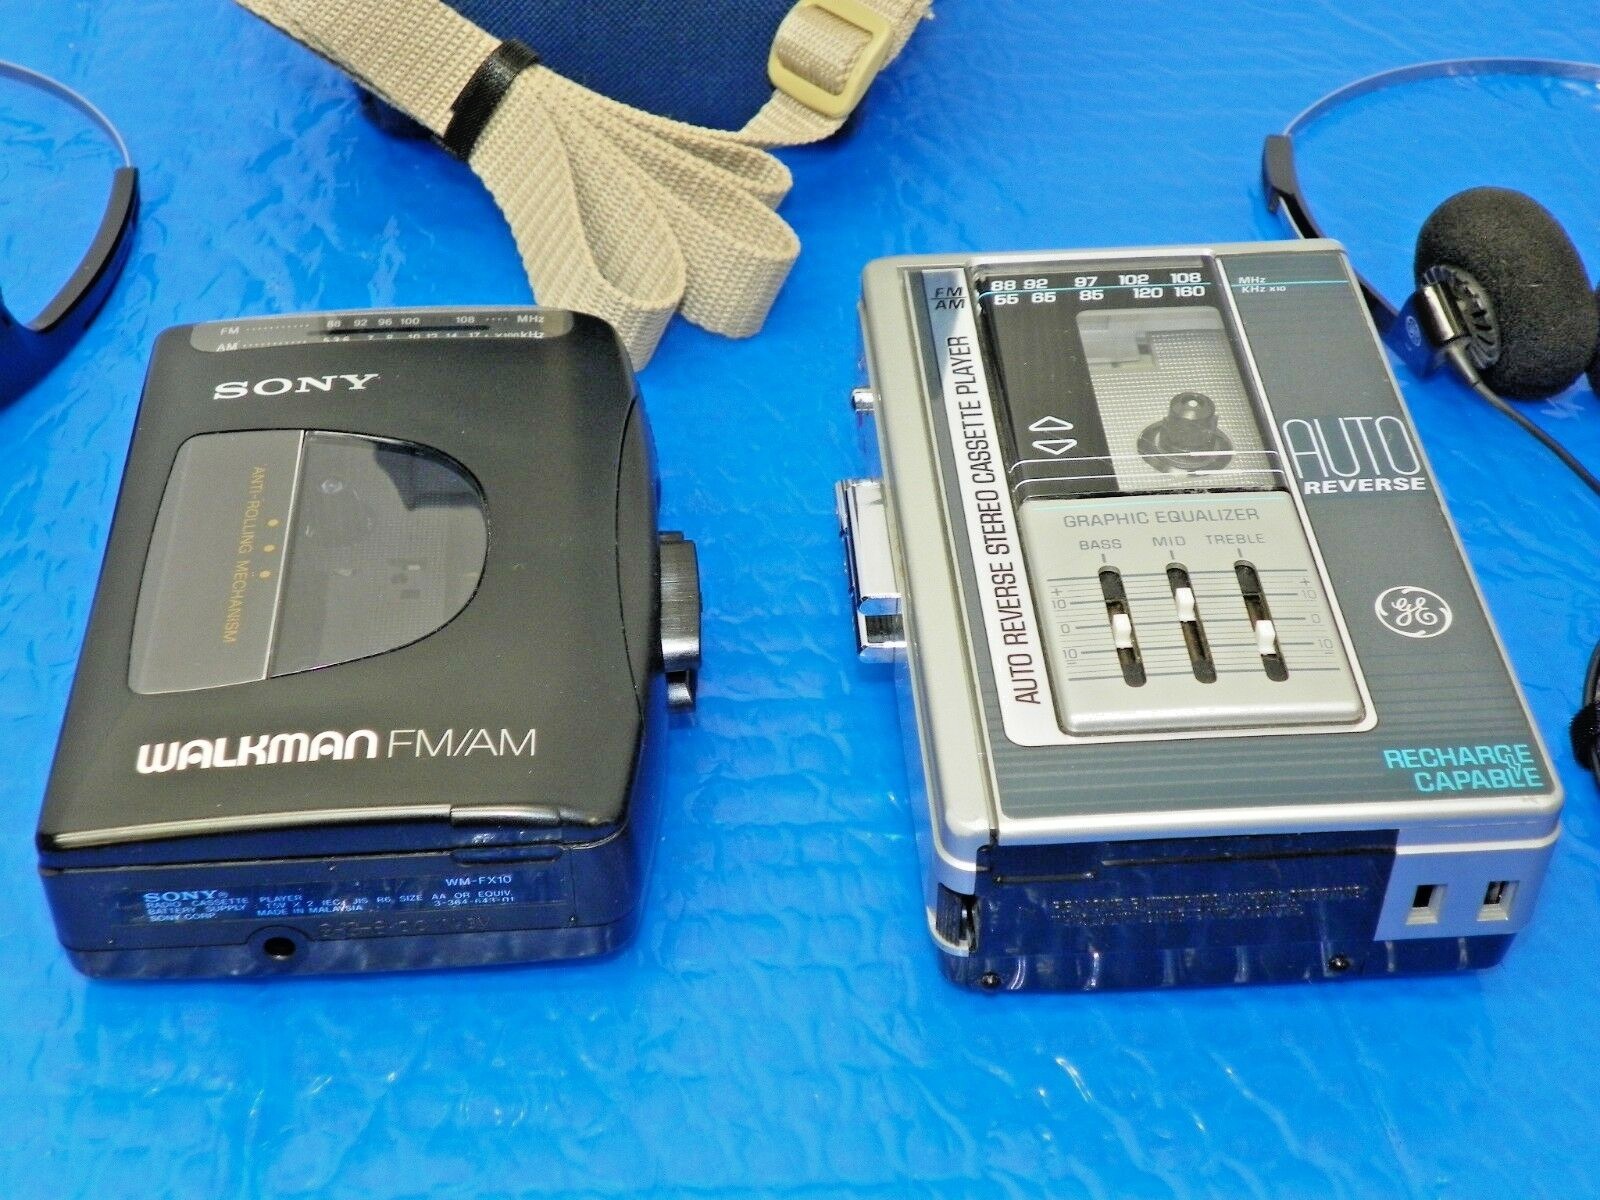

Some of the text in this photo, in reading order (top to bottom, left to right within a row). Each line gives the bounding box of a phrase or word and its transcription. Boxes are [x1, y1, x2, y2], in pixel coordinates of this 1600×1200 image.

[989, 272, 1202, 292] 88 92 97 102 108
[1238, 276, 1266, 285] MHz
[935, 287, 963, 299] FM
[993, 286, 1206, 306] 55 65 85 120 160
[935, 302, 966, 311] AM
[220, 325, 240, 336] FM
[353, 318, 369, 328] 92
[377, 317, 393, 327] 96
[400, 316, 420, 326] 100
[456, 315, 476, 324] 108
[516, 314, 545, 324] MHz
[216, 341, 240, 352] AM
[213, 373, 380, 400] SONY
[1282, 415, 1421, 479] AUTO
[1304, 476, 1427, 495] REVERSE
[946, 334, 1042, 706] AUTO REVERSE STEREO CASSETTE PLAYER
[1063, 507, 1261, 528] GRAPHIC EQUALIZER
[1079, 538, 1123, 551] BASS
[1151, 535, 1187, 547] MID
[1205, 533, 1267, 545] TREBLE
[222, 466, 266, 643] ANTI-ROLLING MECHANISM
[136, 727, 537, 775] WALKMAN FM/AM
[1383, 744, 1535, 769] RECHARGE
[1413, 767, 1544, 793] CAPABLE
[445, 875, 513, 887] WM-FX10
[143, 889, 217, 902] SONY
[259, 895, 302, 903] PLAYER
[400, 894, 423, 902] SIZE
[431, 893, 447, 901] AA
